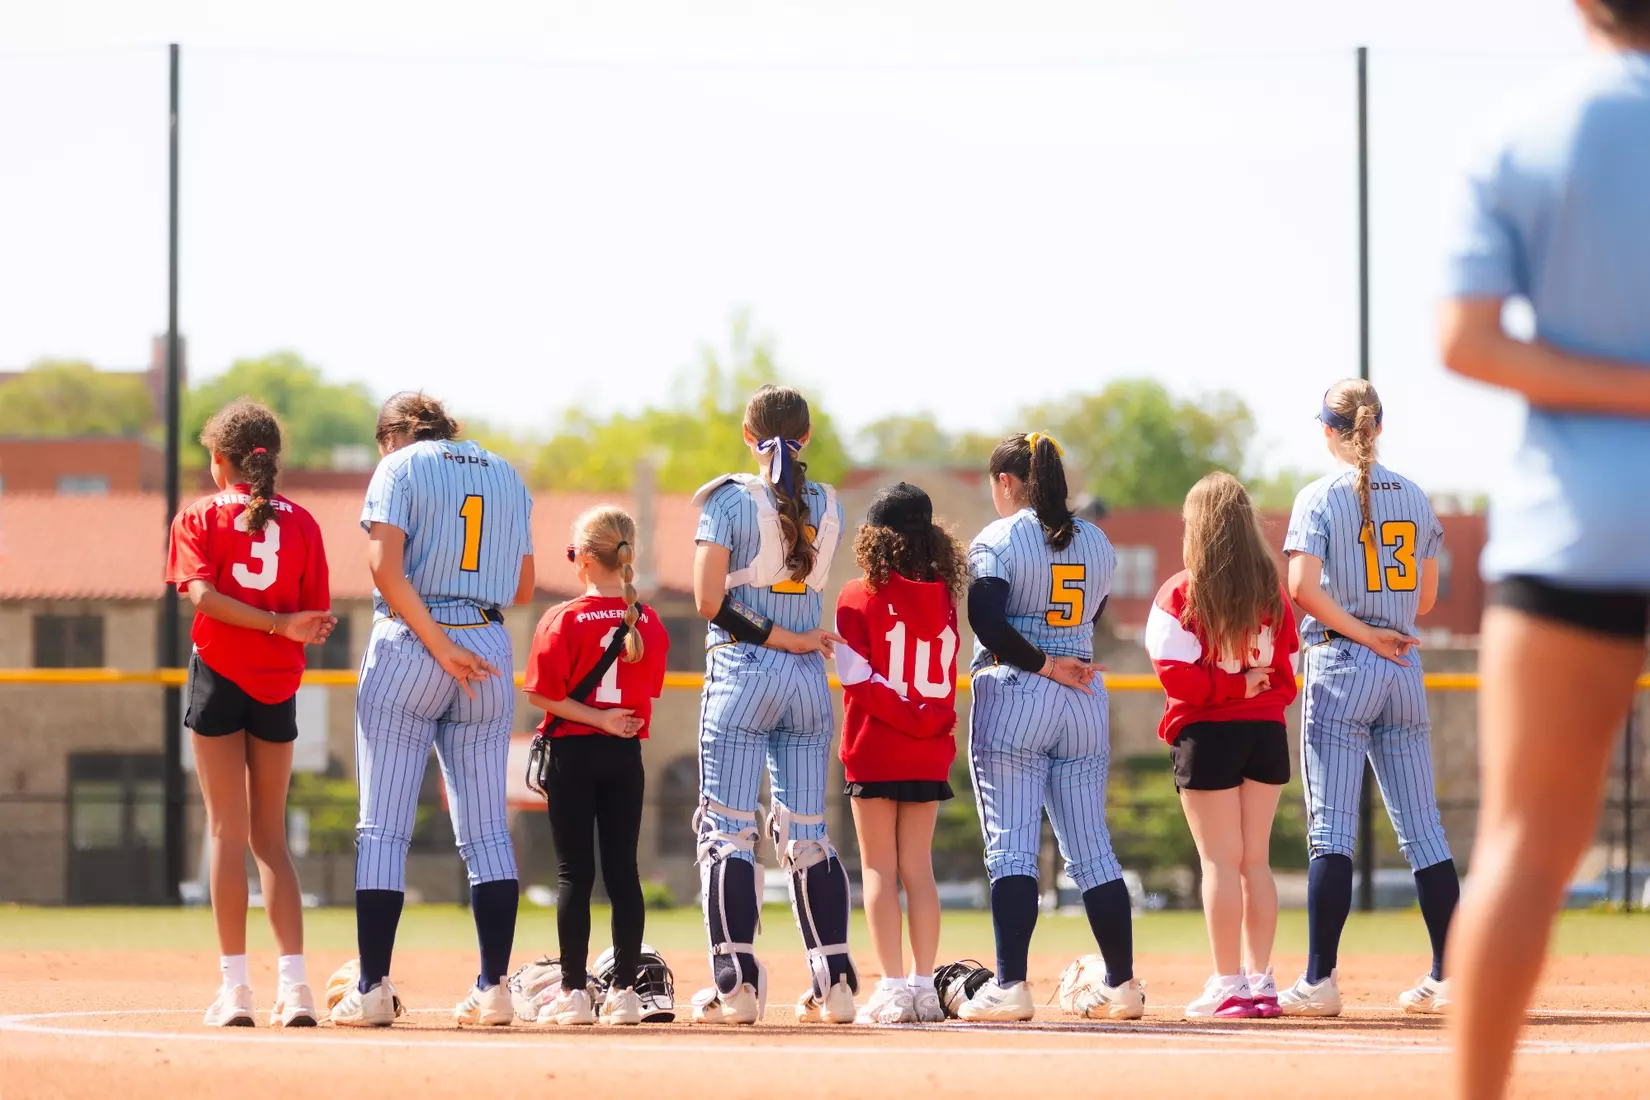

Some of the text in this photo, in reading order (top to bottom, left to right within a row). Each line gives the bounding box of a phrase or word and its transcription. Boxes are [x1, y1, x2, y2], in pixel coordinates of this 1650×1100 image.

[232, 510, 280, 591] 3
[459, 493, 484, 572] 1
[1358, 519, 1418, 593] 13
[576, 609, 649, 624] PINKERN
[1045, 563, 1086, 627] 5
[596, 626, 621, 704] 1
[885, 620, 957, 699] 10
